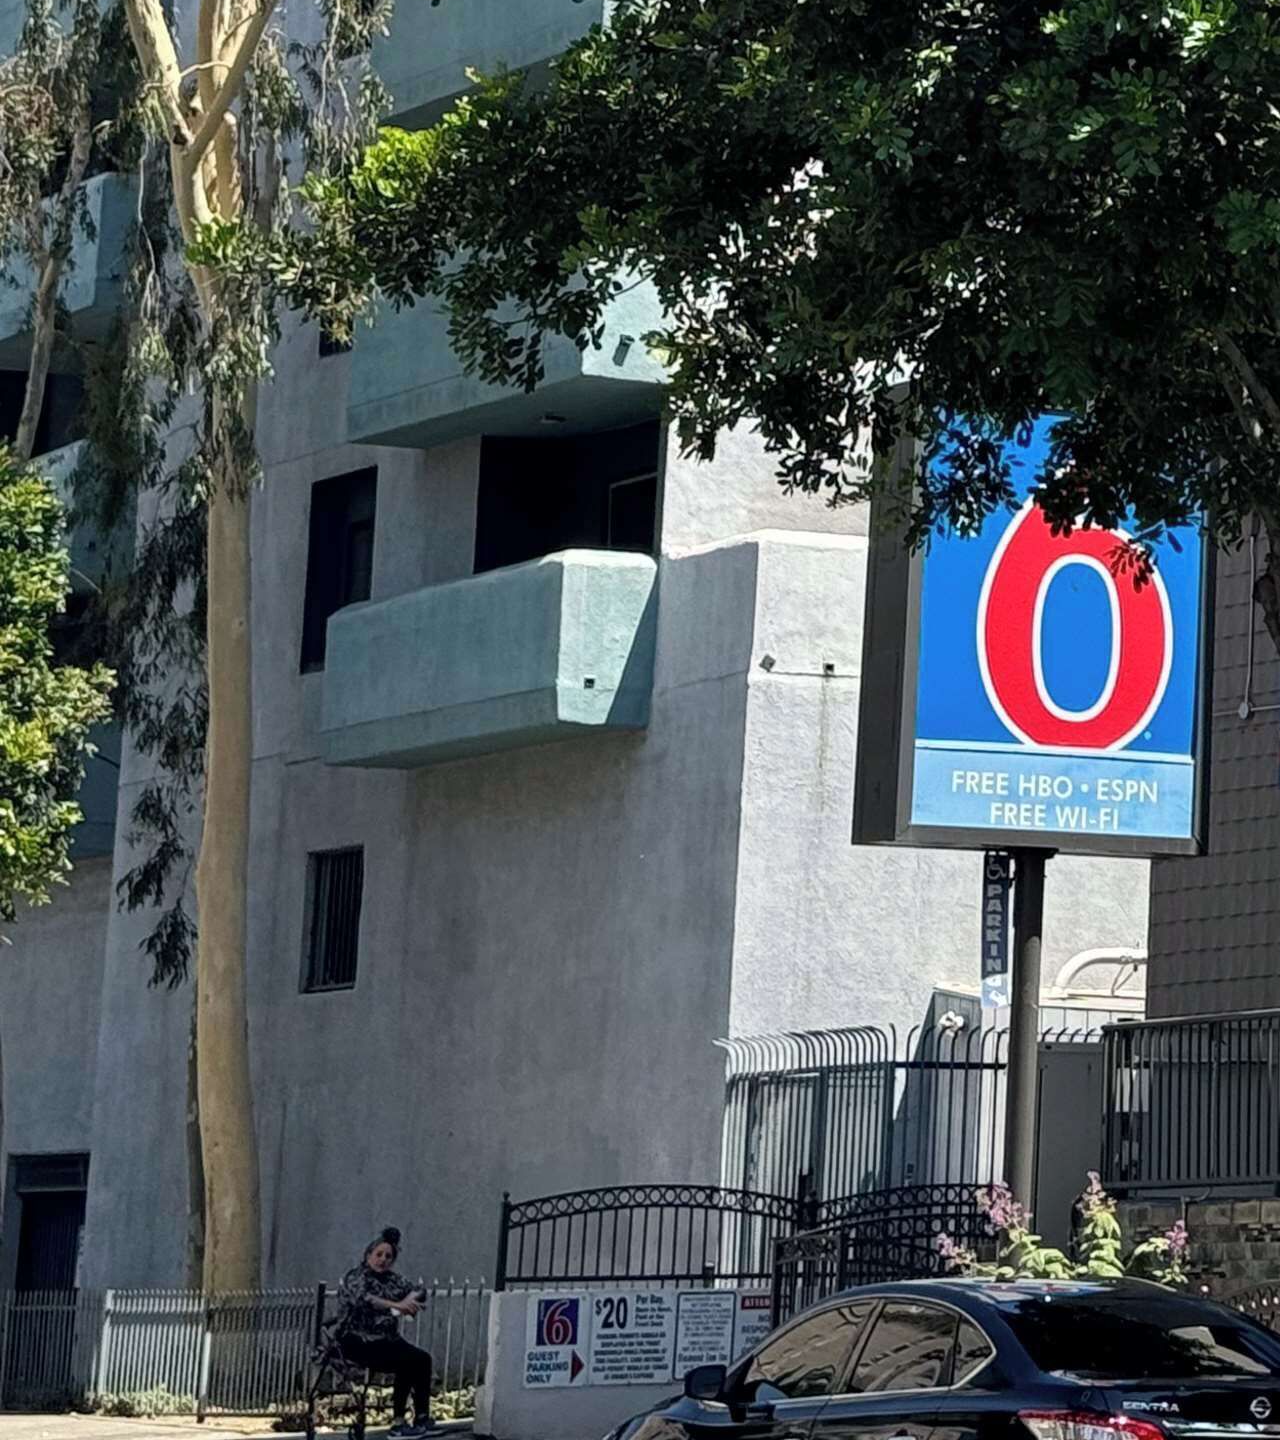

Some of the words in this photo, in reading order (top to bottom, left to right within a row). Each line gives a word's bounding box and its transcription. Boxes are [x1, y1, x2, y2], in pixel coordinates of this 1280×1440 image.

[952, 771, 1008, 795] FREE
[1018, 774, 1073, 799] HBO
[1096, 779, 1158, 803] ESPN
[990, 803, 1047, 826] FREE
[1055, 806, 1118, 830] WI-FI
[543, 1301, 573, 1346] 6
[595, 1296, 628, 1329] $20
[527, 1351, 560, 1361] GUEST
[527, 1361, 569, 1372] PARKING
[526, 1373, 552, 1384] ONLY
